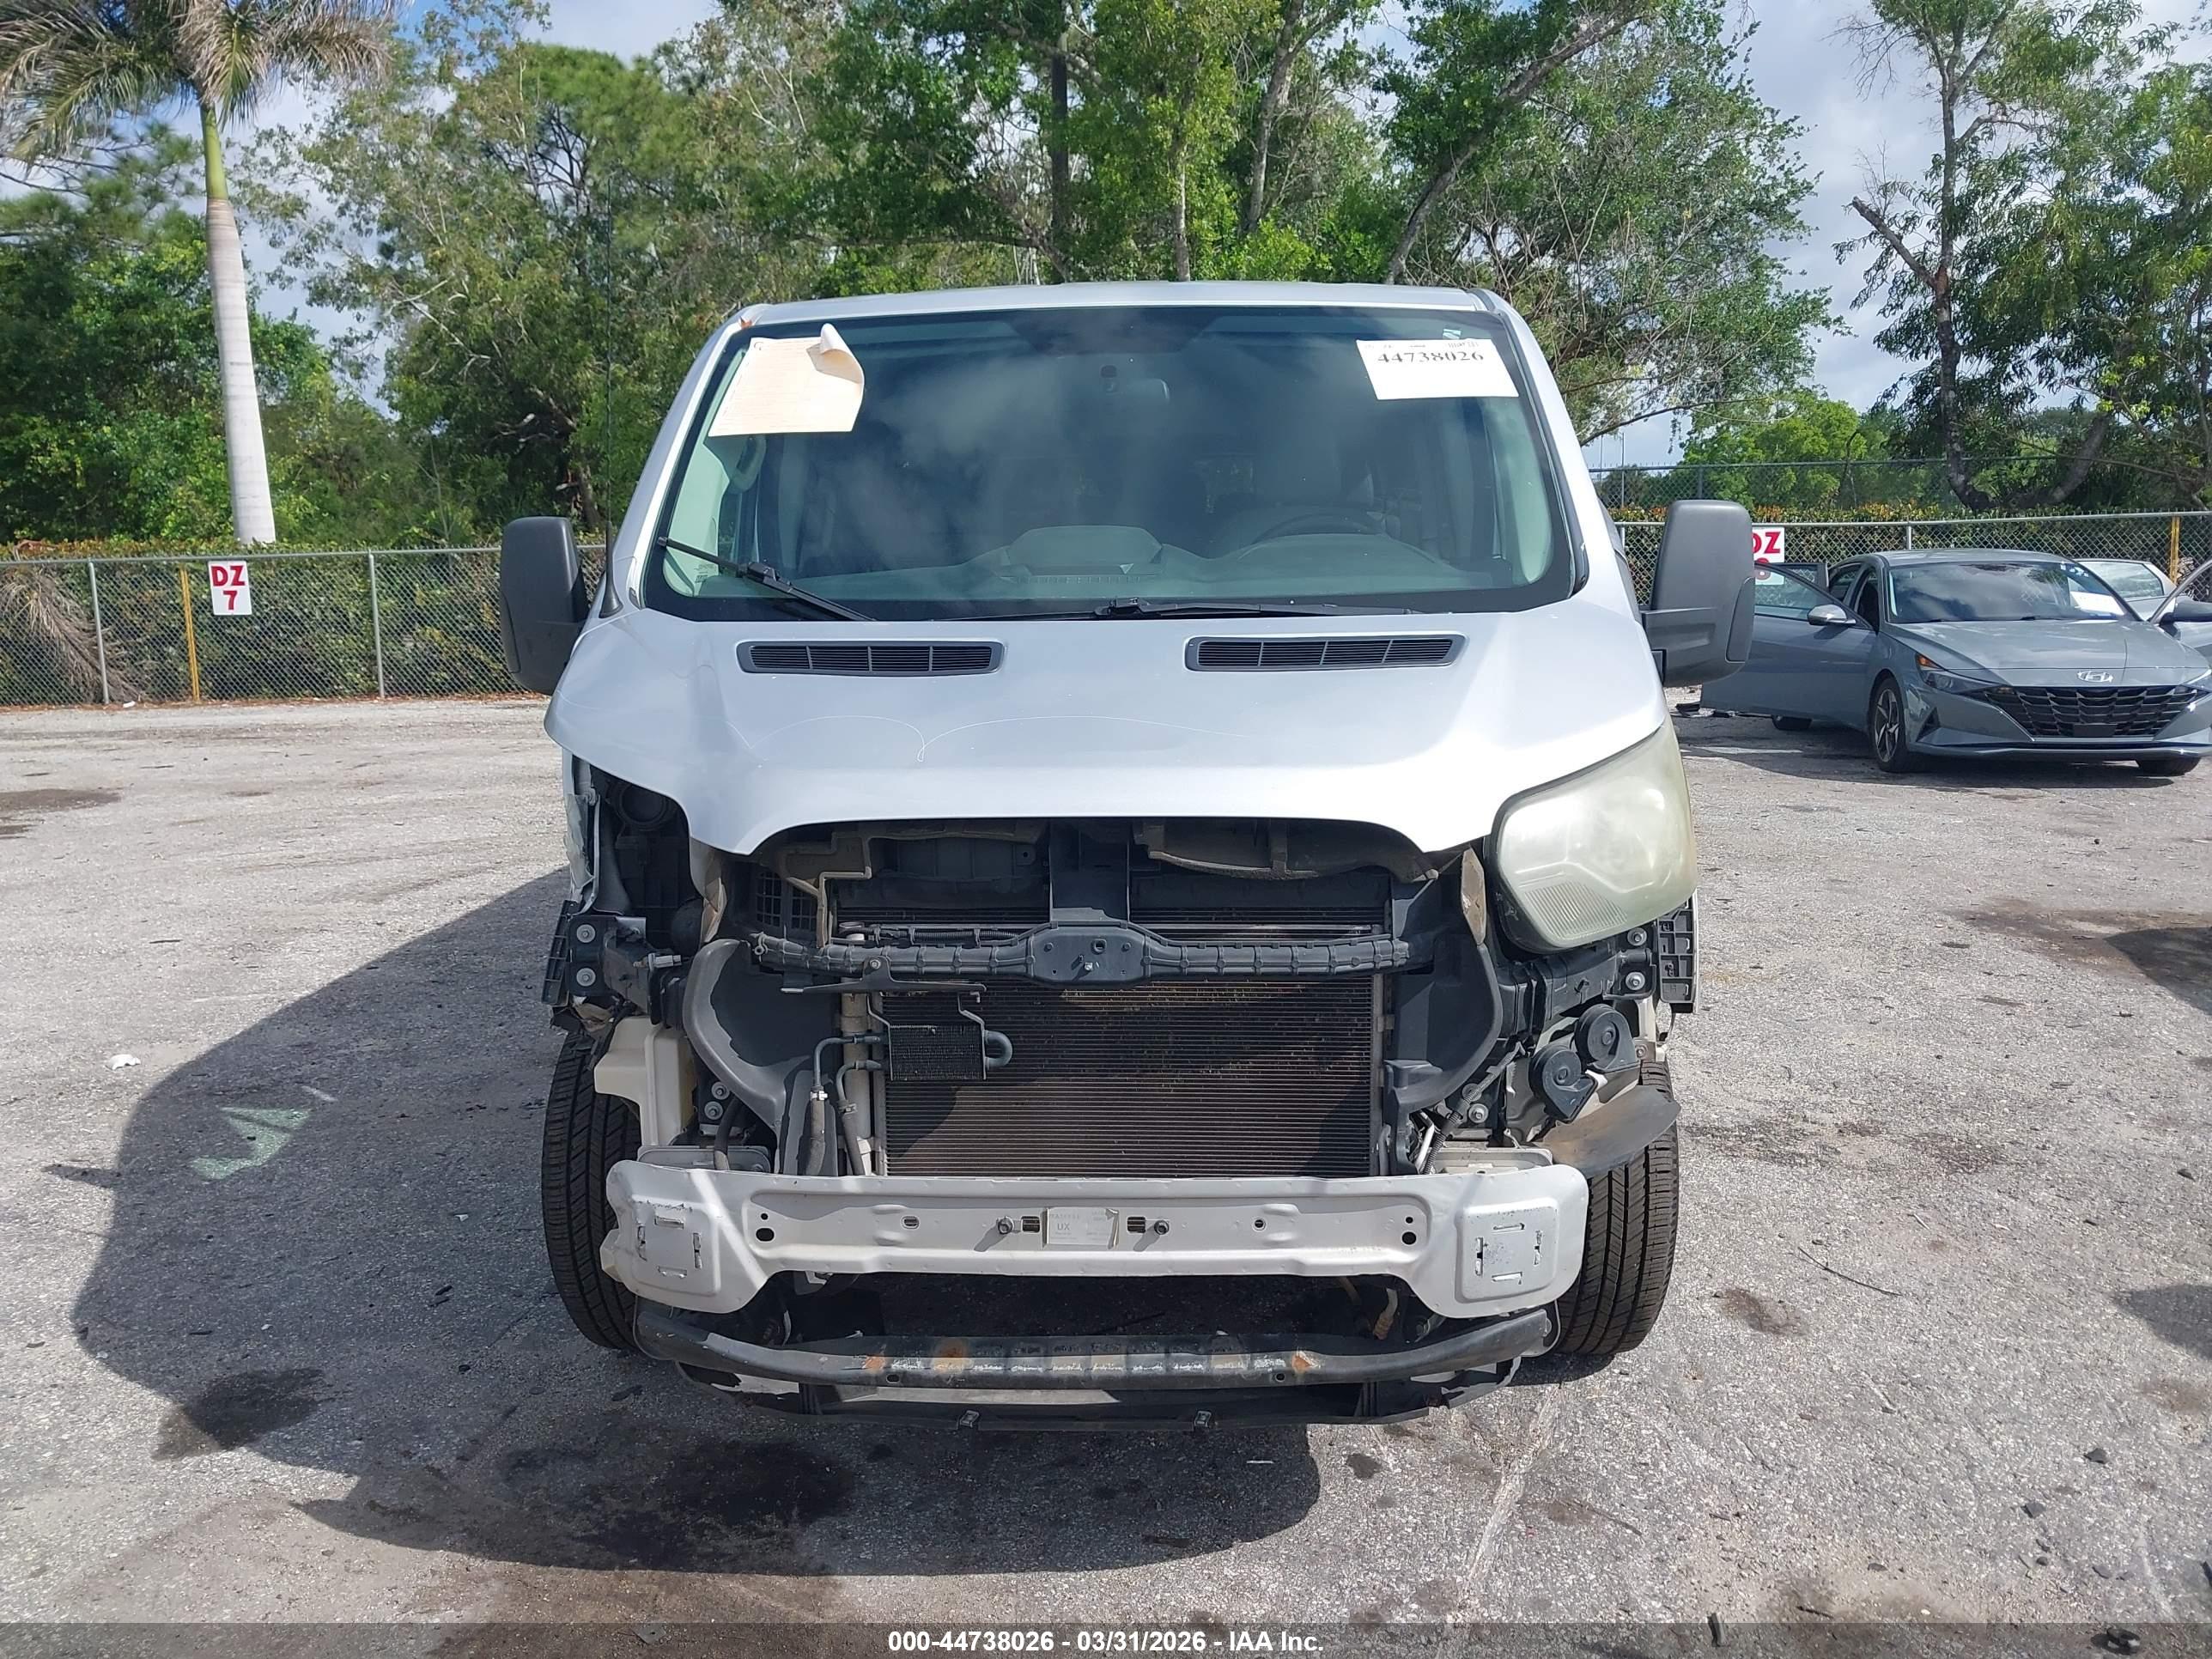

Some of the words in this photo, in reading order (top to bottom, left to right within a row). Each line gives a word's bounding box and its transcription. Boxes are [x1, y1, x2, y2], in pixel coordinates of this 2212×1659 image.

[1377, 350, 1484, 363] 44738026
[210, 565, 246, 586] DZ
[222, 590, 238, 611] 7
